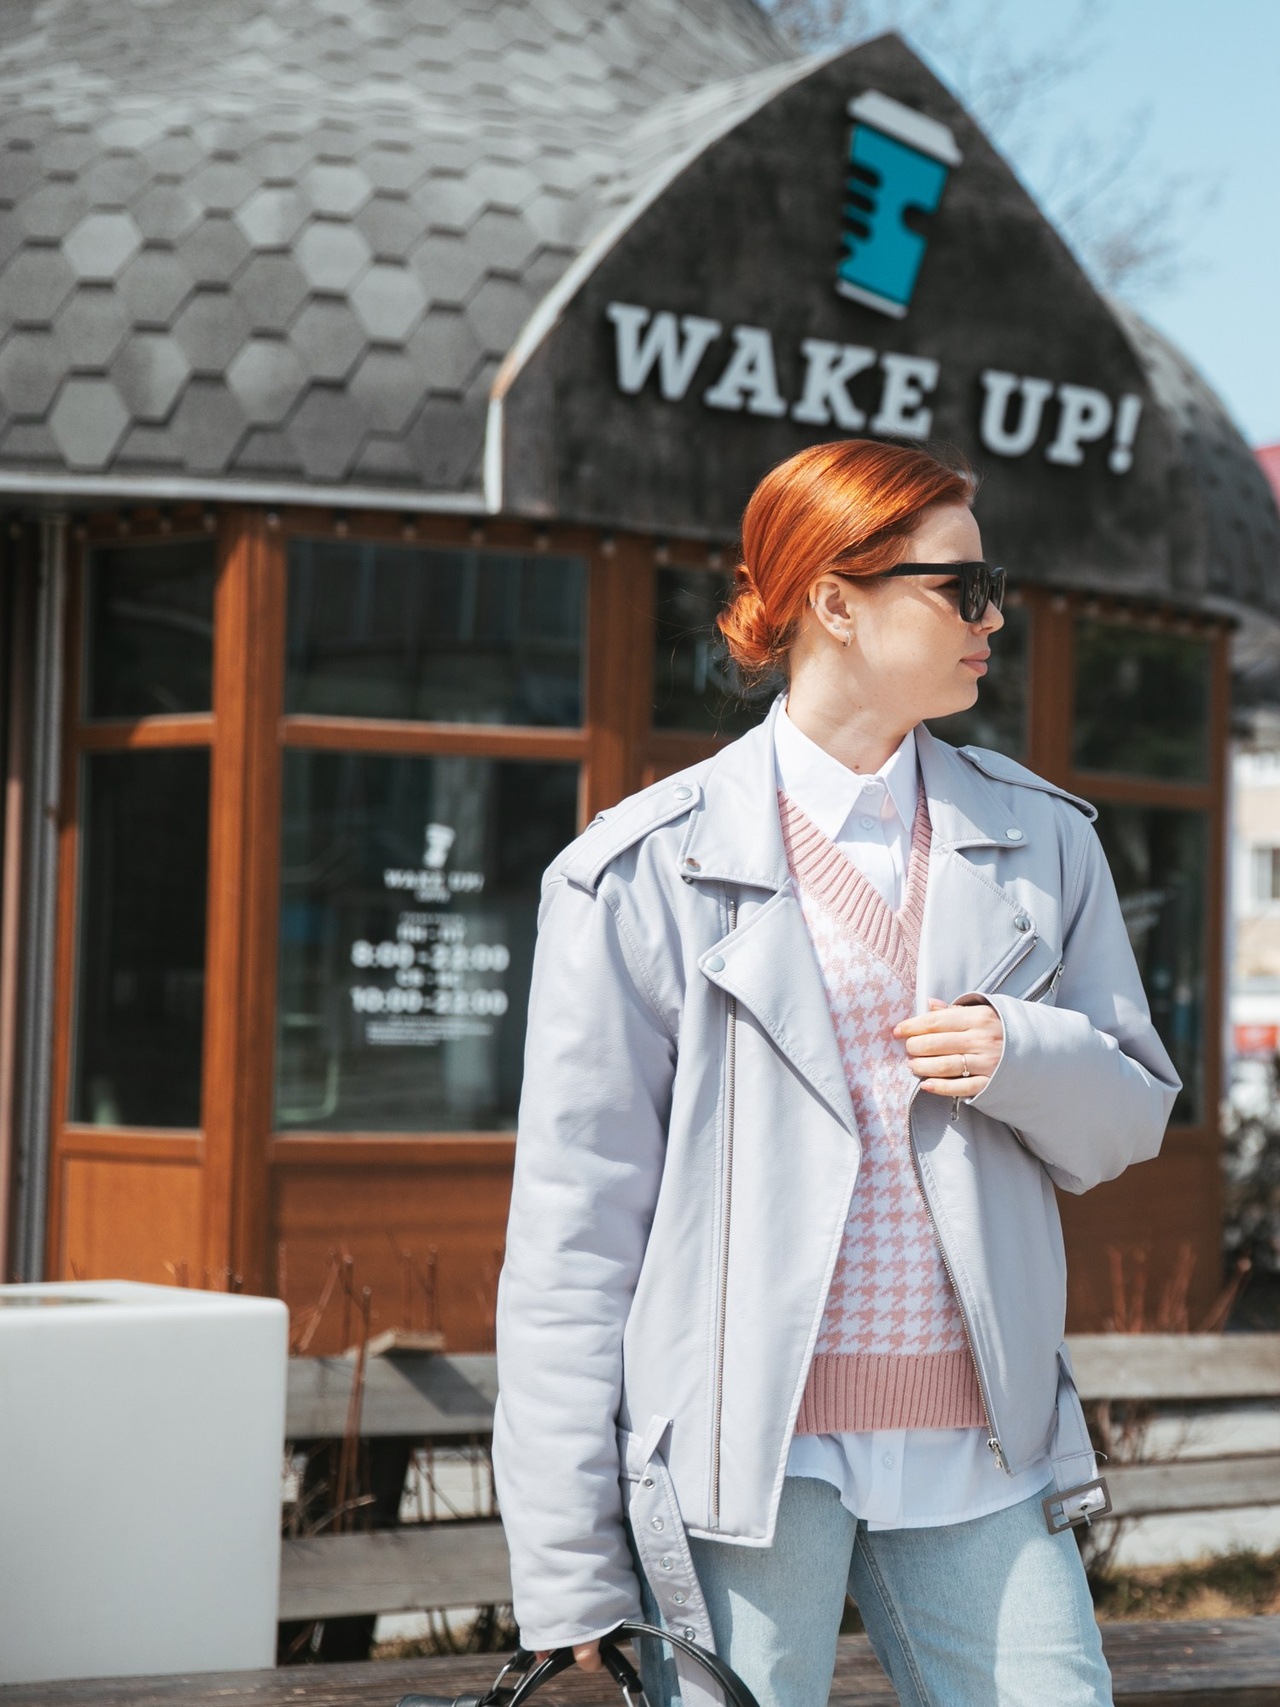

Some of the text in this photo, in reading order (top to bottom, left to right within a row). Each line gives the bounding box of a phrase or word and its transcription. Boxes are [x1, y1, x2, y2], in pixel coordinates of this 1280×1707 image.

[606, 302, 1142, 474] WAKE UP!
[384, 869, 444, 889] WAKE
[352, 941, 415, 968] 8:00
[431, 943, 509, 971] 22:00
[351, 986, 423, 1013] 10:00
[434, 989, 508, 1016] 22:00
